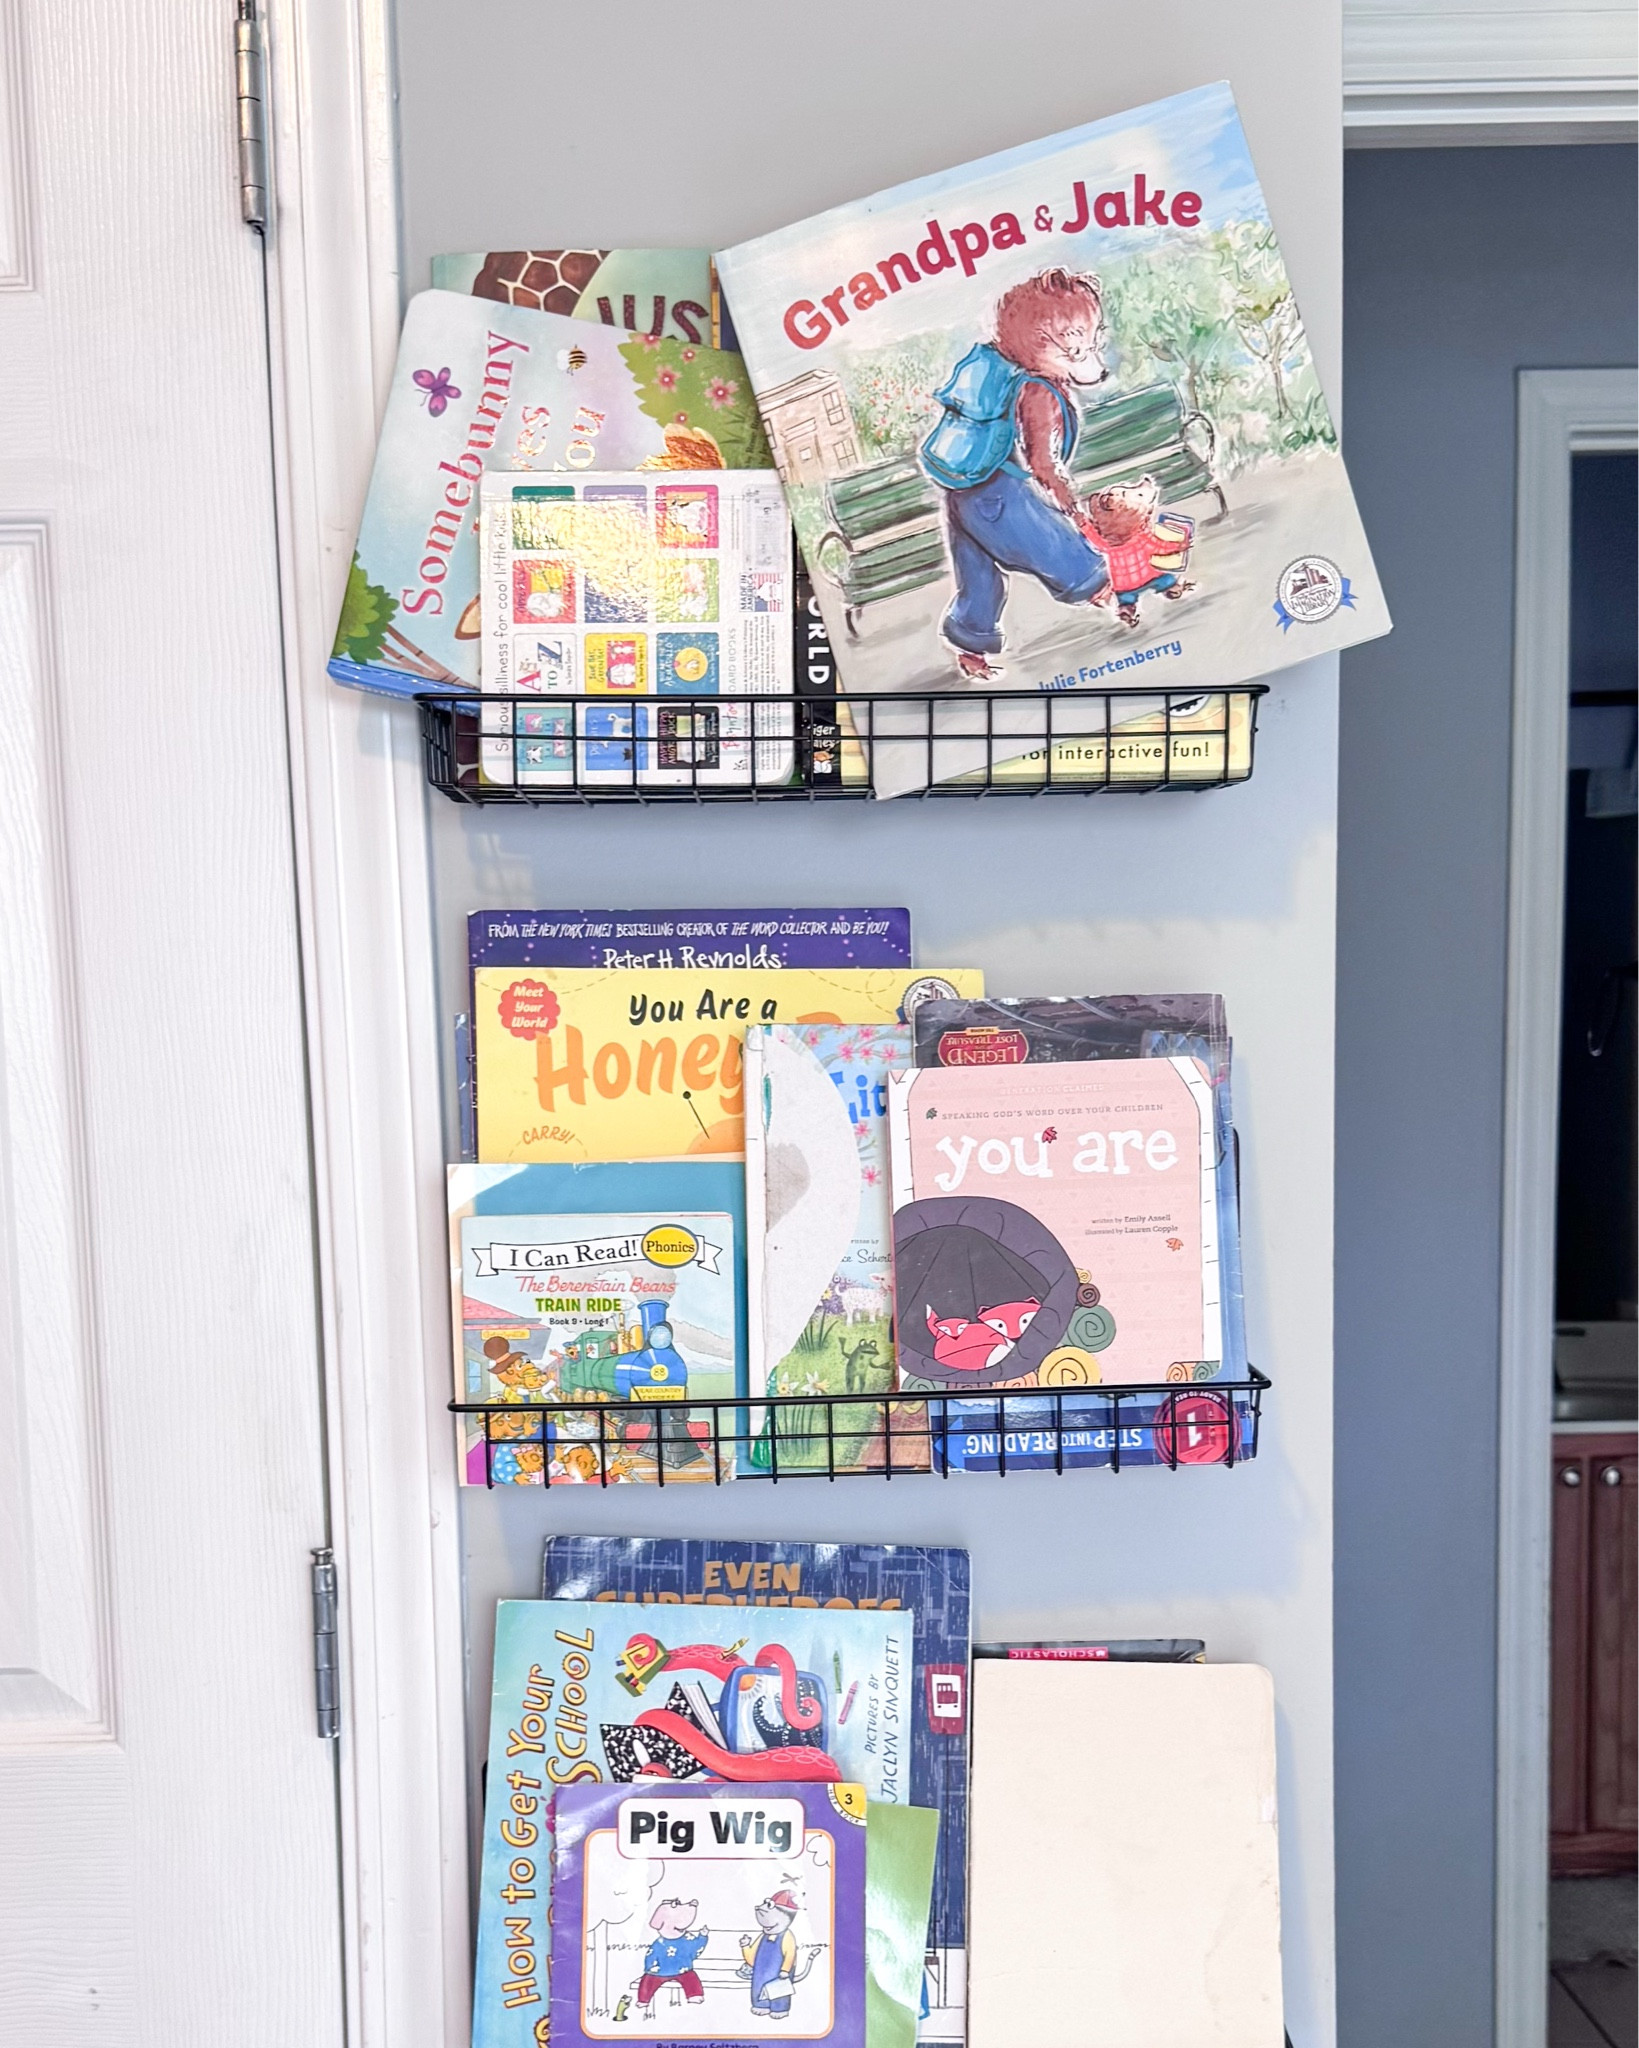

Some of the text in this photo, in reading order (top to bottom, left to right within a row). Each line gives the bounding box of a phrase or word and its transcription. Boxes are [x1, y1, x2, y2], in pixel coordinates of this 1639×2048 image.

[782, 174, 1203, 350] Grandpa & Jake
[402, 330, 530, 615] Somebunny
[494, 580, 509, 610] cool
[493, 613, 508, 638] for
[537, 641, 562, 662] Z
[1078, 640, 1183, 683] Fortenberry
[494, 643, 509, 695] silliness
[547, 670, 558, 689] TO
[727, 665, 737, 692] OARD
[516, 669, 541, 693] A
[1058, 743, 1163, 760] interactive
[1172, 741, 1211, 759] fun!
[488, 922, 520, 938] FROM
[521, 922, 538, 938] THE
[538, 922, 559, 938] NEW
[559, 922, 584, 938] YORK
[616, 922, 674, 937] BESTSELLING
[676, 922, 715, 937] CREATOR
[716, 922, 728, 937] OF
[731, 921, 748, 936] THE
[750, 921, 778, 937] WORD
[779, 921, 828, 936] COLLECTOR
[829, 921, 851, 936] AND
[852, 921, 865, 936] BE
[865, 920, 890, 936] YOU!
[603, 947, 655, 968] Peter
[513, 986, 544, 998] Meet
[514, 1001, 544, 1014] Your
[696, 988, 749, 1021] Are
[761, 999, 778, 1021] a
[511, 1016, 549, 1029] World
[994, 1034, 1018, 1044] LOST
[947, 1044, 1019, 1064] LEGEND
[1062, 1083, 1104, 1093] CLAIMED
[941, 1104, 1163, 1120] SPEAKING GOD'S WORD OVER YOUR CHILDREN
[522, 1125, 576, 1145] CARRY!
[934, 1129, 1179, 1192] you are
[1124, 1215, 1147, 1223] Emily
[1124, 1226, 1152, 1234] Lauren
[509, 1239, 638, 1268] I Can Read!
[645, 1240, 696, 1254] Phonics
[515, 1275, 679, 1293] The Berenstain Bears
[535, 1297, 622, 1313] TRAIN RIDE
[549, 1317, 570, 1325] Book
[653, 1367, 666, 1377] 88
[1095, 1428, 1143, 1449] STEP
[1186, 1411, 1203, 1448] 1
[962, 1431, 1055, 1454] READING
[704, 1560, 800, 1592] EVEN
[1011, 1649, 1096, 1659] SCHOLASTIC
[506, 1662, 556, 1758] Your
[864, 1673, 879, 1754] PICTURES BY
[880, 1634, 899, 1804] JACLYN SINQUETT
[500, 1769, 542, 1849] Get
[844, 1793, 853, 1805] 3
[630, 1810, 793, 1853] Pig Wig
[500, 1856, 537, 1905] to
